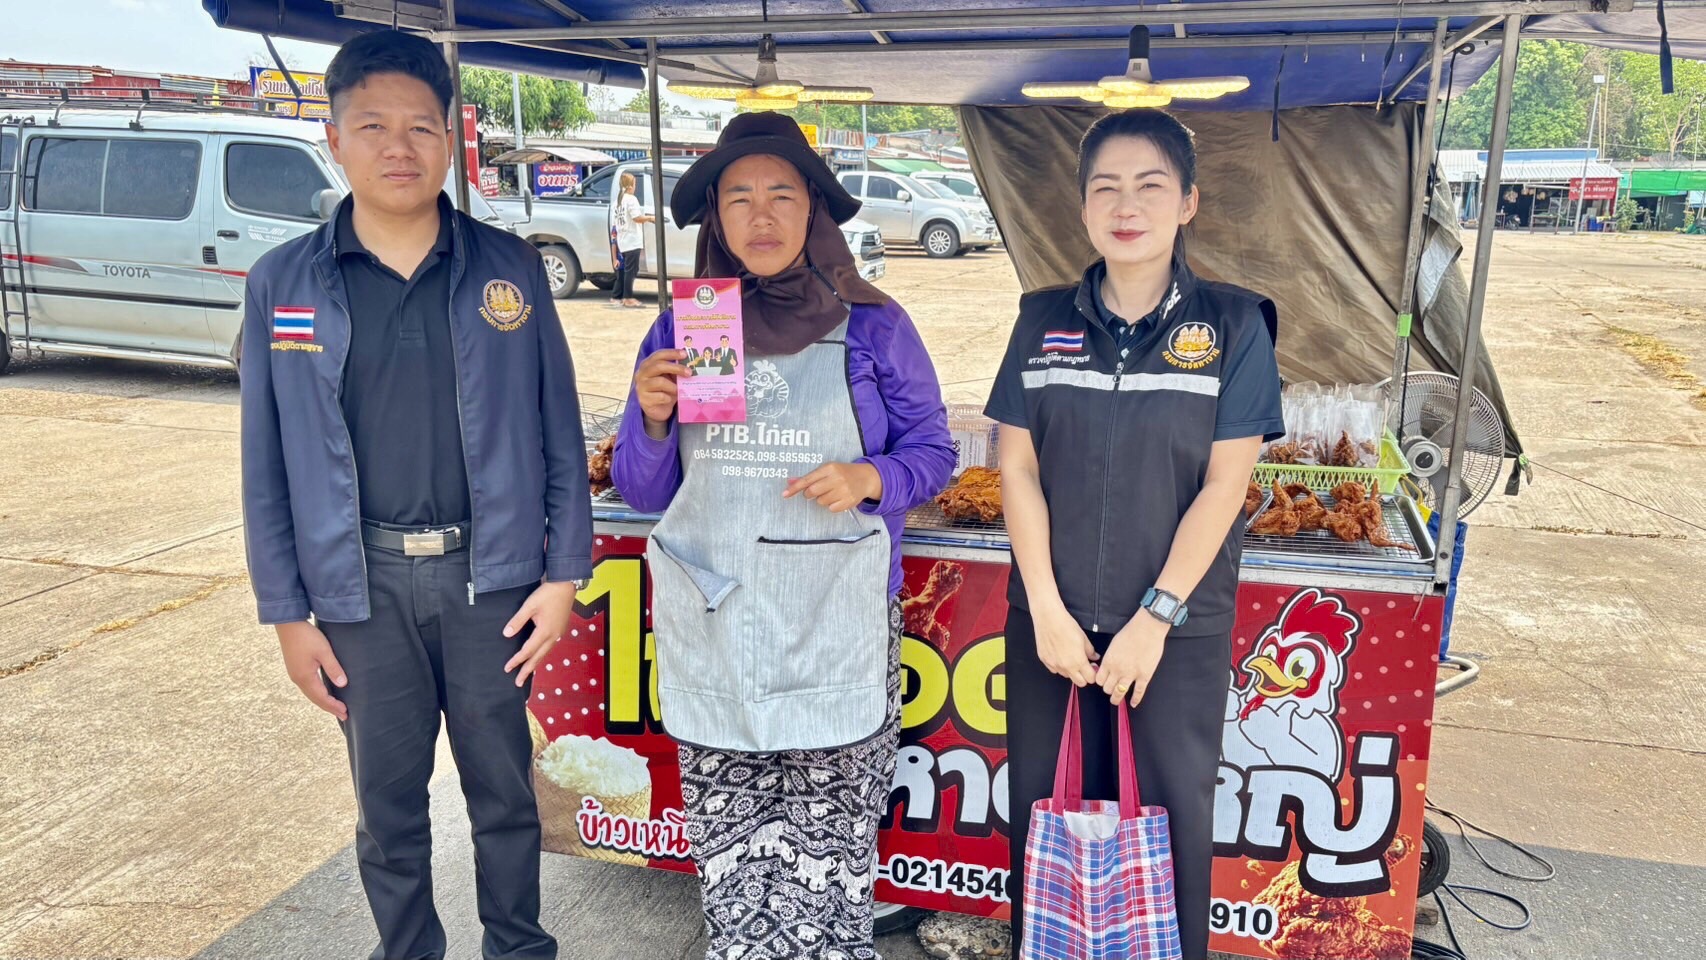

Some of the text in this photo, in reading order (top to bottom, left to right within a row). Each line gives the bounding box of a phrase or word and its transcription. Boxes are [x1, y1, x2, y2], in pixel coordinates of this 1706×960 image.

[103, 264, 151, 279] TOYOTA
[1162, 347, 1221, 369] กรมการจัดหางาน
[706, 421, 811, 447] PTB.ไก่สด
[722, 465, 788, 479] 098-9670343
[878, 857, 1011, 901] -021454
[1211, 902, 1273, 935] 910
